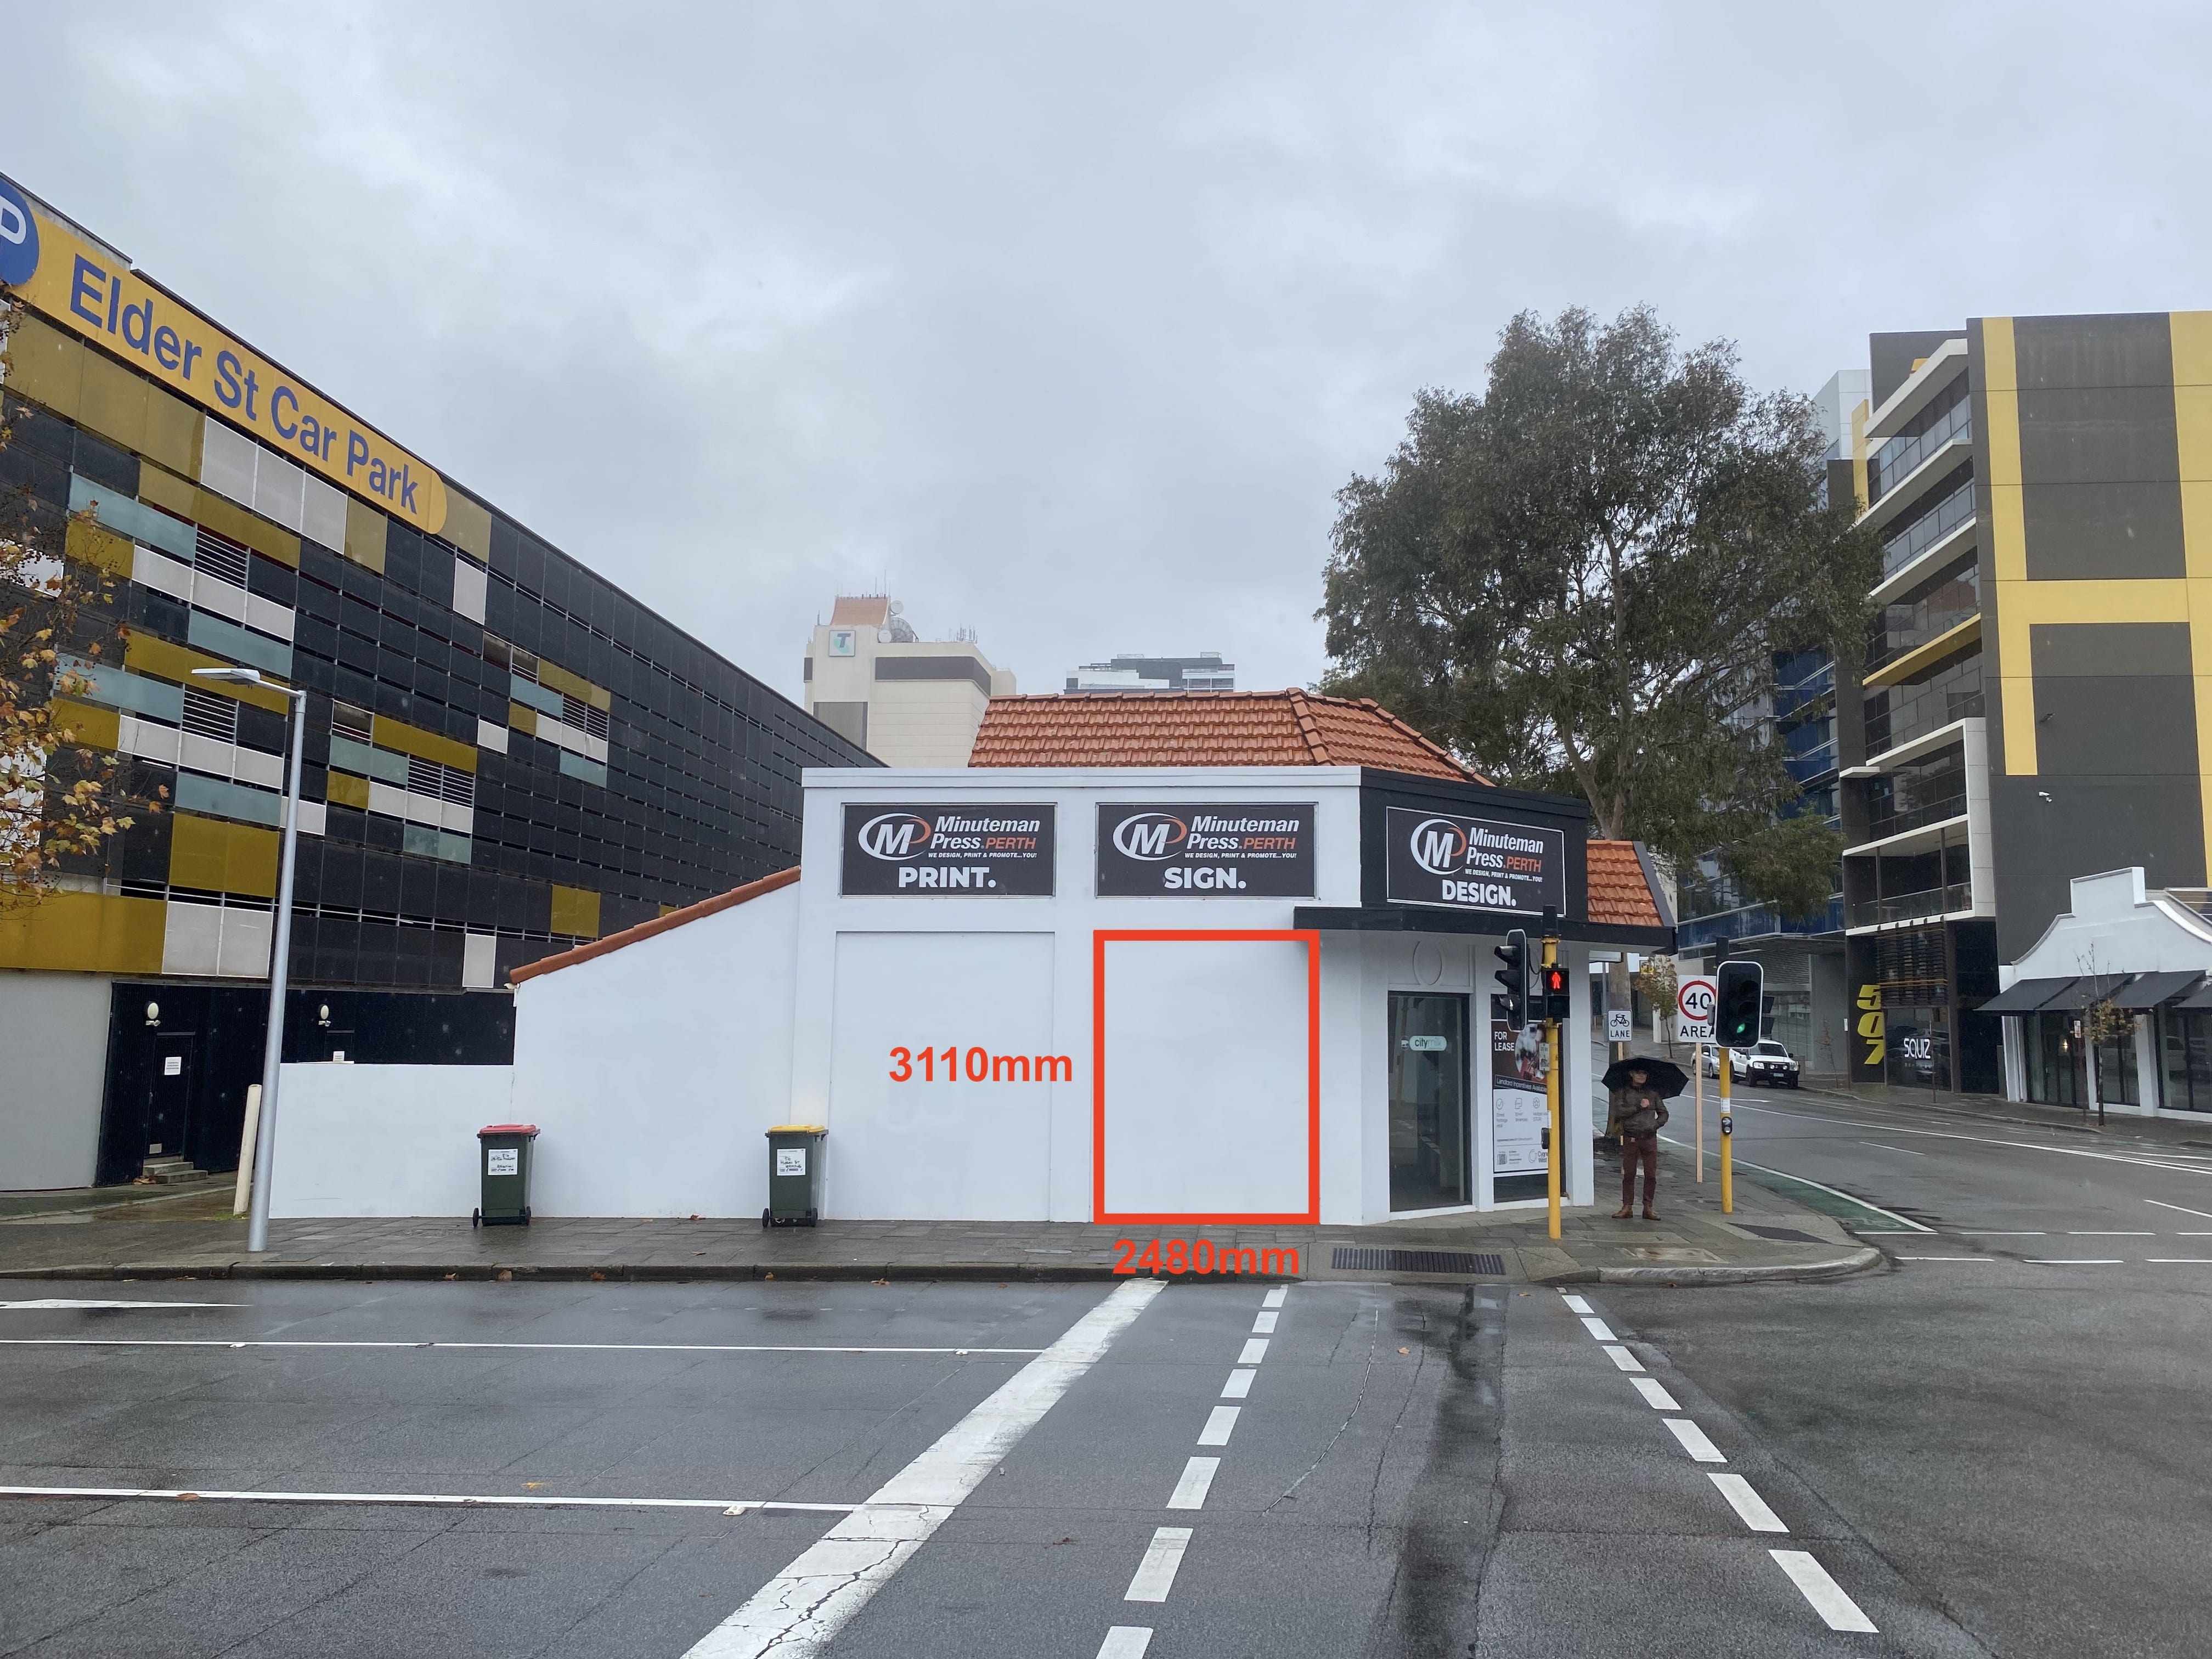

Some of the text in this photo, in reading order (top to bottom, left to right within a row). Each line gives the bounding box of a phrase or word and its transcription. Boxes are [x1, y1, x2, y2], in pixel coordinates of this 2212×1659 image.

[70, 253, 419, 515] Elder St Car Park
[837, 633, 851, 648] T
[935, 816, 1040, 832] Minuteman
[1191, 816, 1300, 832] Minuteman
[1469, 827, 1544, 854] Minuteman
[899, 867, 996, 888] PRINT.
[1164, 867, 1246, 889] SIGN.
[1472, 870, 1490, 878] DESIGN,
[1442, 879, 1516, 906] DESIGN.
[1685, 992, 1712, 1009] 40
[1494, 1031, 1508, 1040] FOR
[1680, 1025, 1714, 1038] AREA
[1494, 1042, 1515, 1051] LEASE
[1904, 1037, 1931, 1059] SQUIZ
